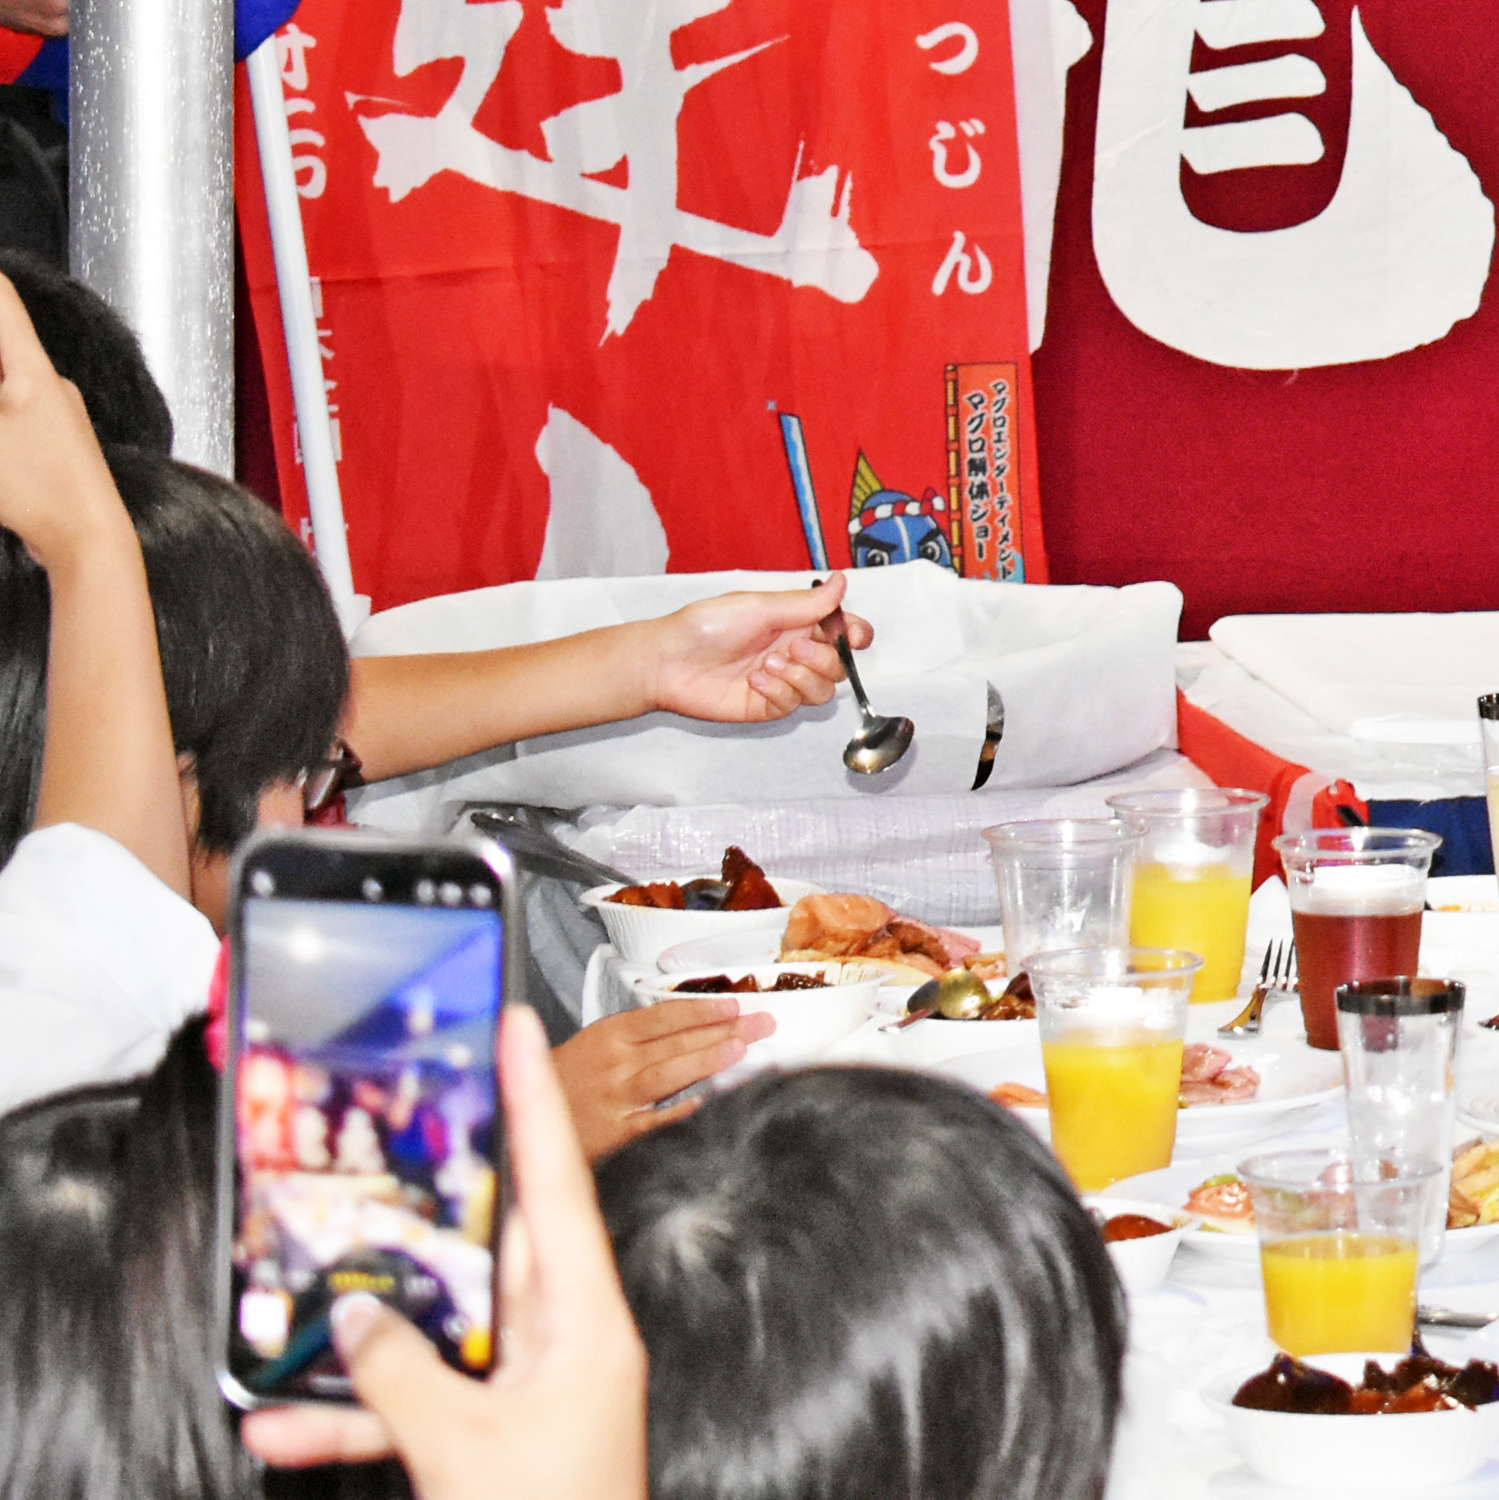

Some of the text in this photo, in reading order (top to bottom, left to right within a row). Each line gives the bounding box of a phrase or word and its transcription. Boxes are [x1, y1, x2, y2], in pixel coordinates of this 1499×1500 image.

[966, 391, 991, 560] マグロ解体ショー
